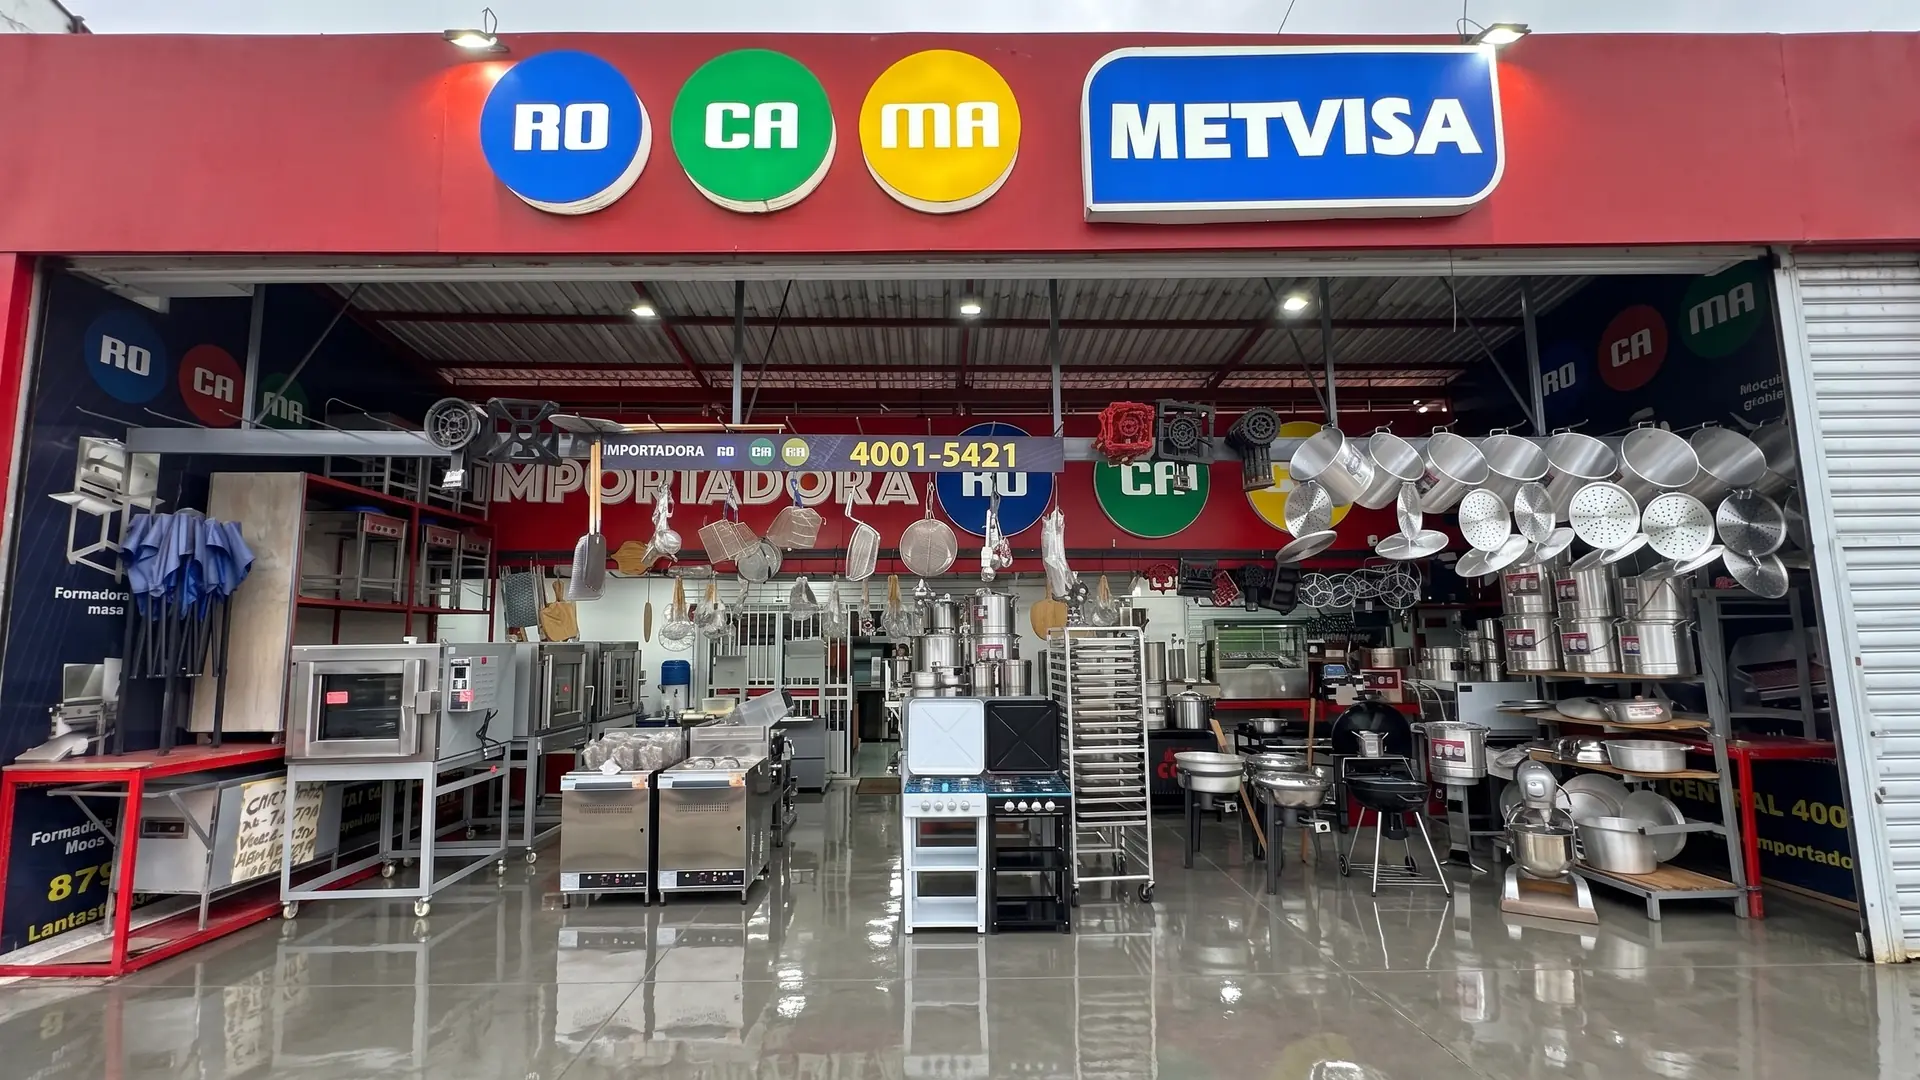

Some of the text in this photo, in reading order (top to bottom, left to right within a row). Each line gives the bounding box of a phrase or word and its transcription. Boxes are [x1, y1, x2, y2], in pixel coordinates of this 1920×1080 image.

[513, 101, 1000, 151] RO CA MA
[1110, 97, 1484, 160] METVISA
[1542, 281, 1756, 397] RO CA MA
[99, 334, 304, 425] RO CA MA
[603, 443, 705, 458] IMPORTADORA
[849, 441, 1017, 468] 4001-5421
[473, 458, 920, 505] IMPORTADORA
[962, 471, 1028, 497] RO
[54, 586, 130, 601] Formadora
[87, 605, 124, 615] masa
[65, 836, 105, 855] Moos
